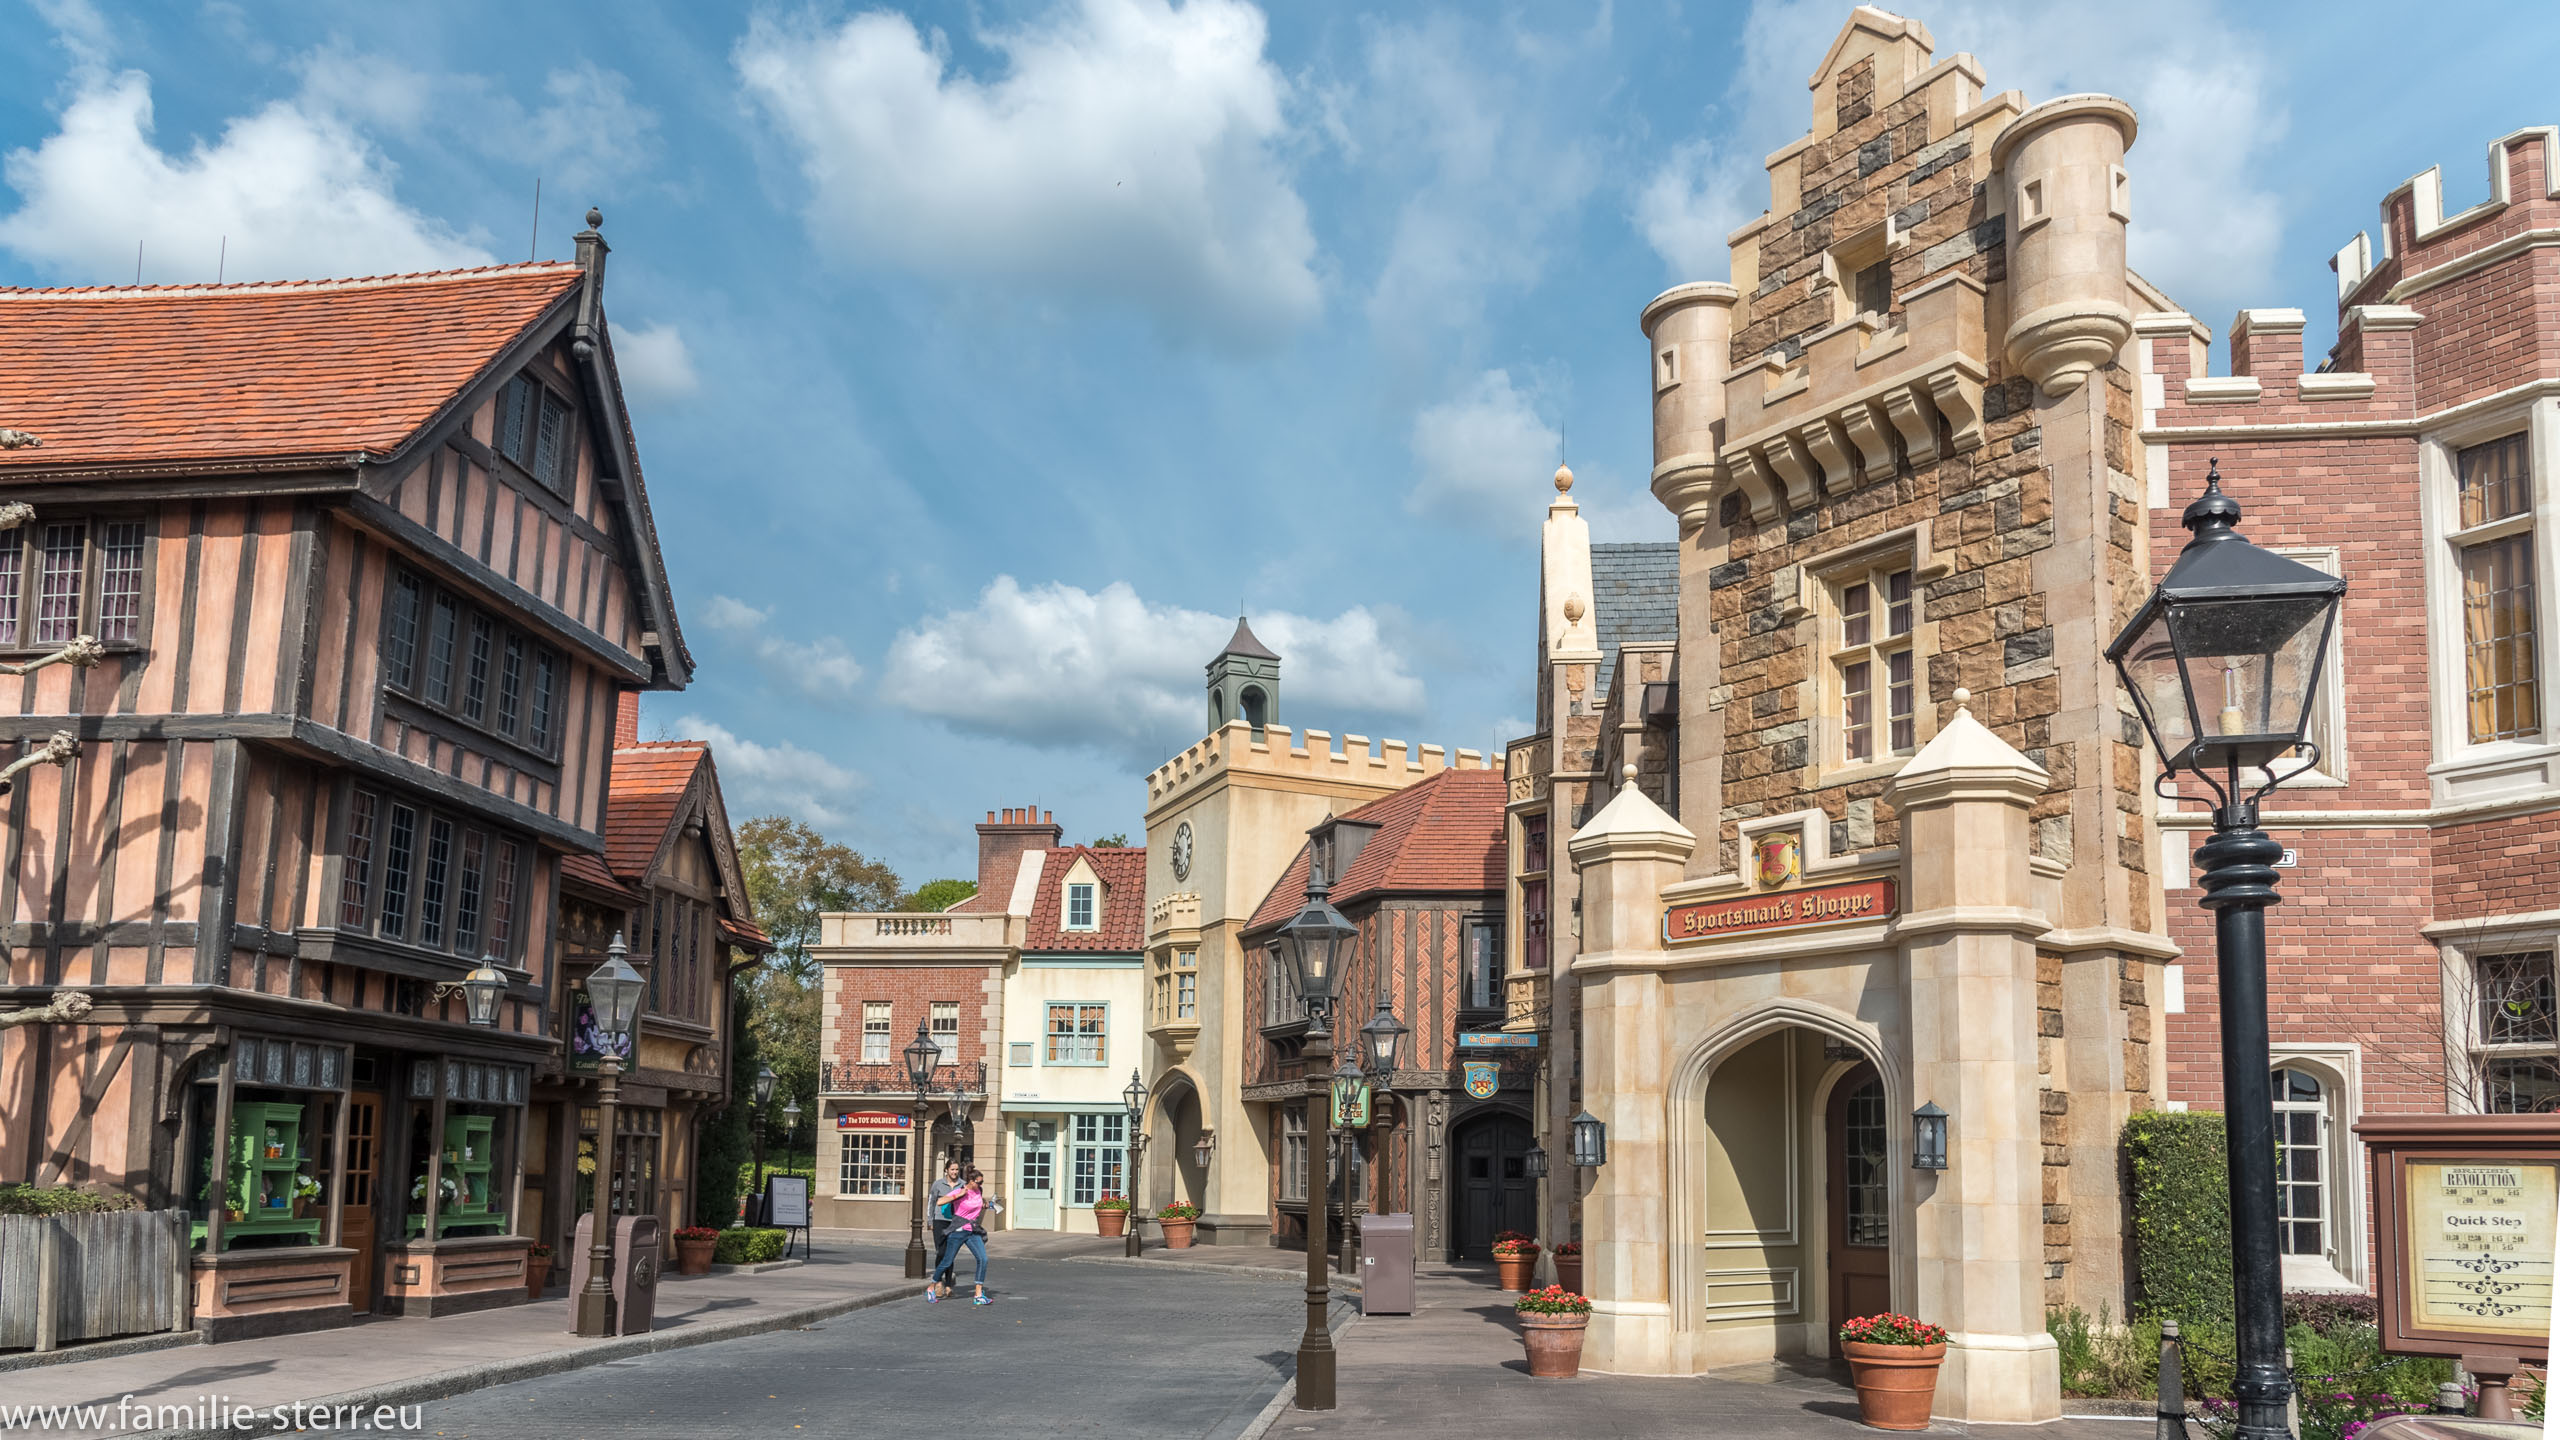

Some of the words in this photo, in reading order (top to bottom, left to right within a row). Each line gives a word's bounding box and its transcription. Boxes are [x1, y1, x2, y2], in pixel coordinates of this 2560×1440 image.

[1684, 899, 1793, 934] Sportsman's
[1801, 893, 1873, 919] Shoppe
[848, 1116, 858, 1124] The
[858, 1116, 870, 1124] TOY
[870, 1116, 897, 1124] SOLDIER
[2447, 1173, 2516, 1187] REVOLUTION
[2447, 1215, 2487, 1226] Quick
